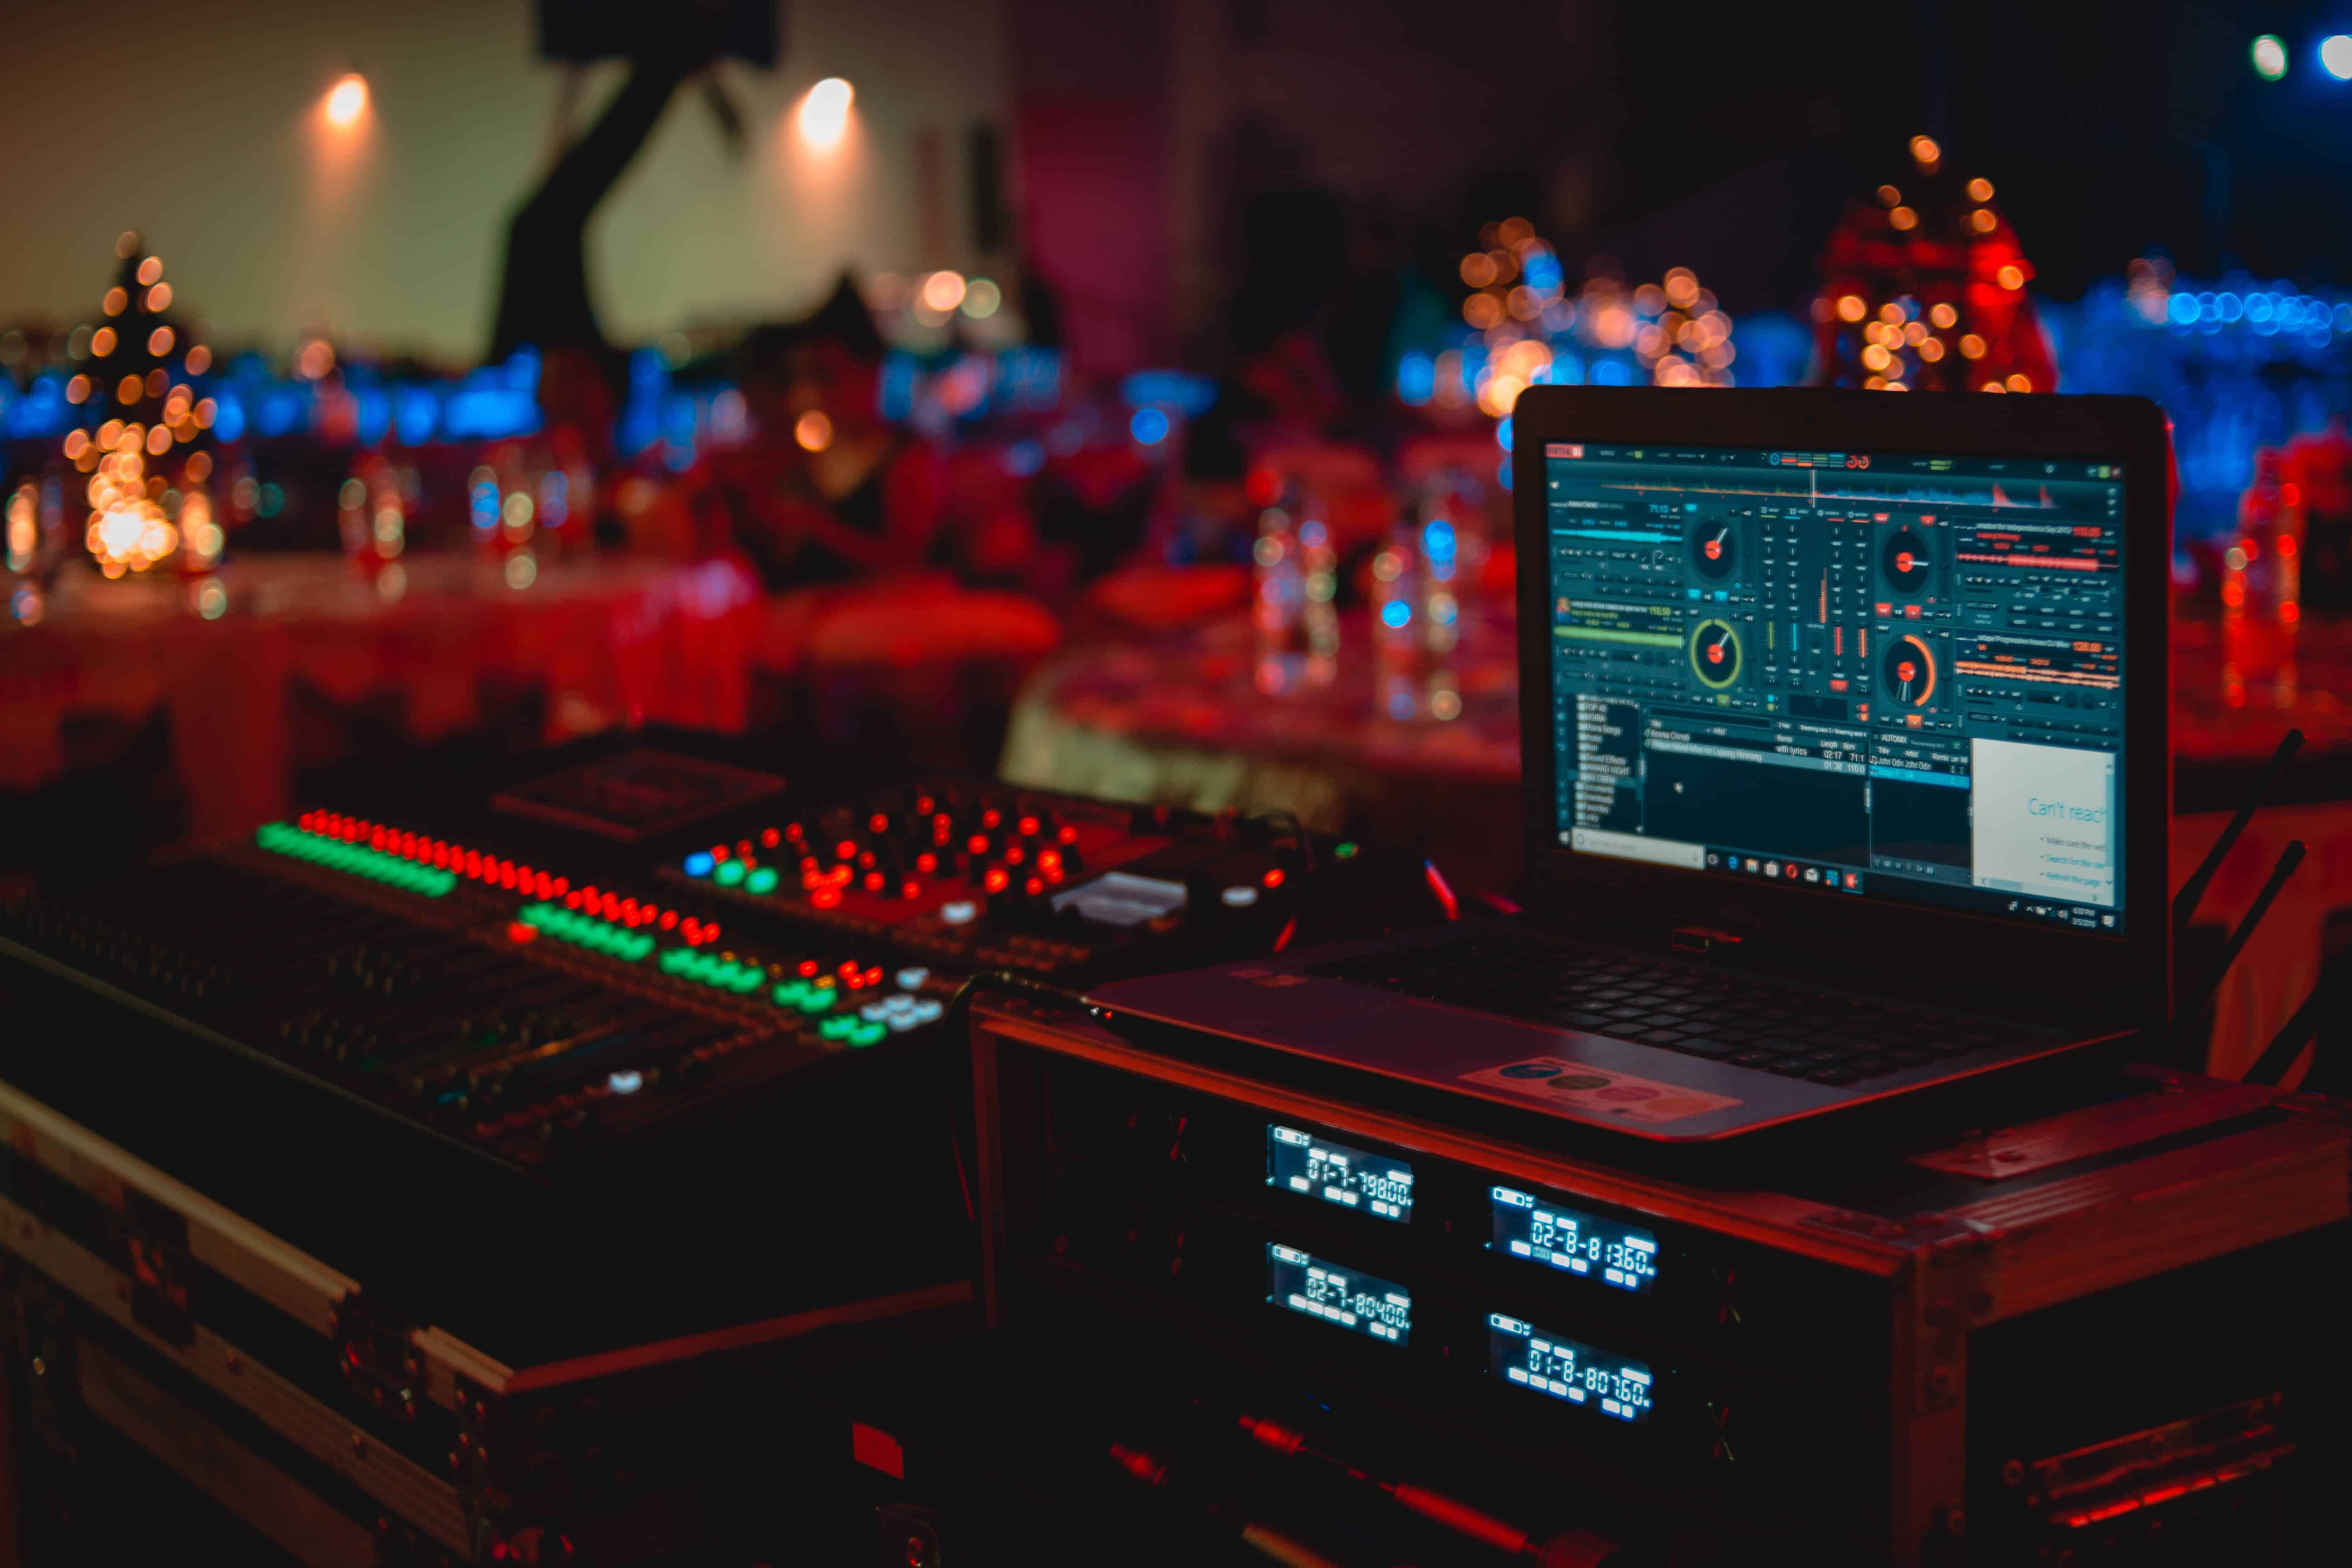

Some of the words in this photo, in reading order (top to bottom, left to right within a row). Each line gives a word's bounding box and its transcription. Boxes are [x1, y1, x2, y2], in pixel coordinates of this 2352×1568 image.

[1649, 504, 1668, 514] 71.13
[1585, 703, 1597, 712] TOP
[1585, 713, 1606, 723] MOIRA
[1585, 723, 1602, 732] Moira
[1602, 725, 1621, 735] Songs
[1585, 734, 1603, 743] music
[1651, 729, 1670, 738] Anima
[1671, 730, 1690, 741] Christi
[1881, 733, 1907, 744] AUTOMIX
[1820, 740, 1838, 749] Length
[1842, 742, 1855, 751] Bpm
[1713, 747, 1735, 759] Lupang
[1736, 750, 1762, 763] Hinirang
[1775, 745, 1789, 754] with
[1789, 746, 1808, 756] lyrics
[1823, 750, 1842, 760] 02:17
[1877, 746, 1890, 755] Title
[1906, 750, 1919, 758] Artist
[1586, 753, 1604, 763] Sound
[1606, 755, 1627, 765] Effects
[1850, 753, 1864, 763] 71.1
[1878, 757, 1891, 766] John
[1891, 759, 1904, 767] Odin
[1586, 764, 1610, 774] AWARD
[1611, 765, 1631, 777] NIGHT
[1824, 761, 1842, 771] 01:38
[1847, 764, 1865, 774] 110.0
[1905, 760, 1918, 769] John
[1919, 762, 1931, 771] Odin
[1583, 783, 1615, 794] Documents
[1583, 793, 1613, 804] Downloads
[1583, 803, 1609, 814] Favorites
[2028, 798, 2065, 819] Can't
[2047, 837, 2064, 846] Make
[2046, 854, 2068, 864] Search
[2046, 871, 2070, 882] Refresh
[2083, 878, 2101, 889] page
